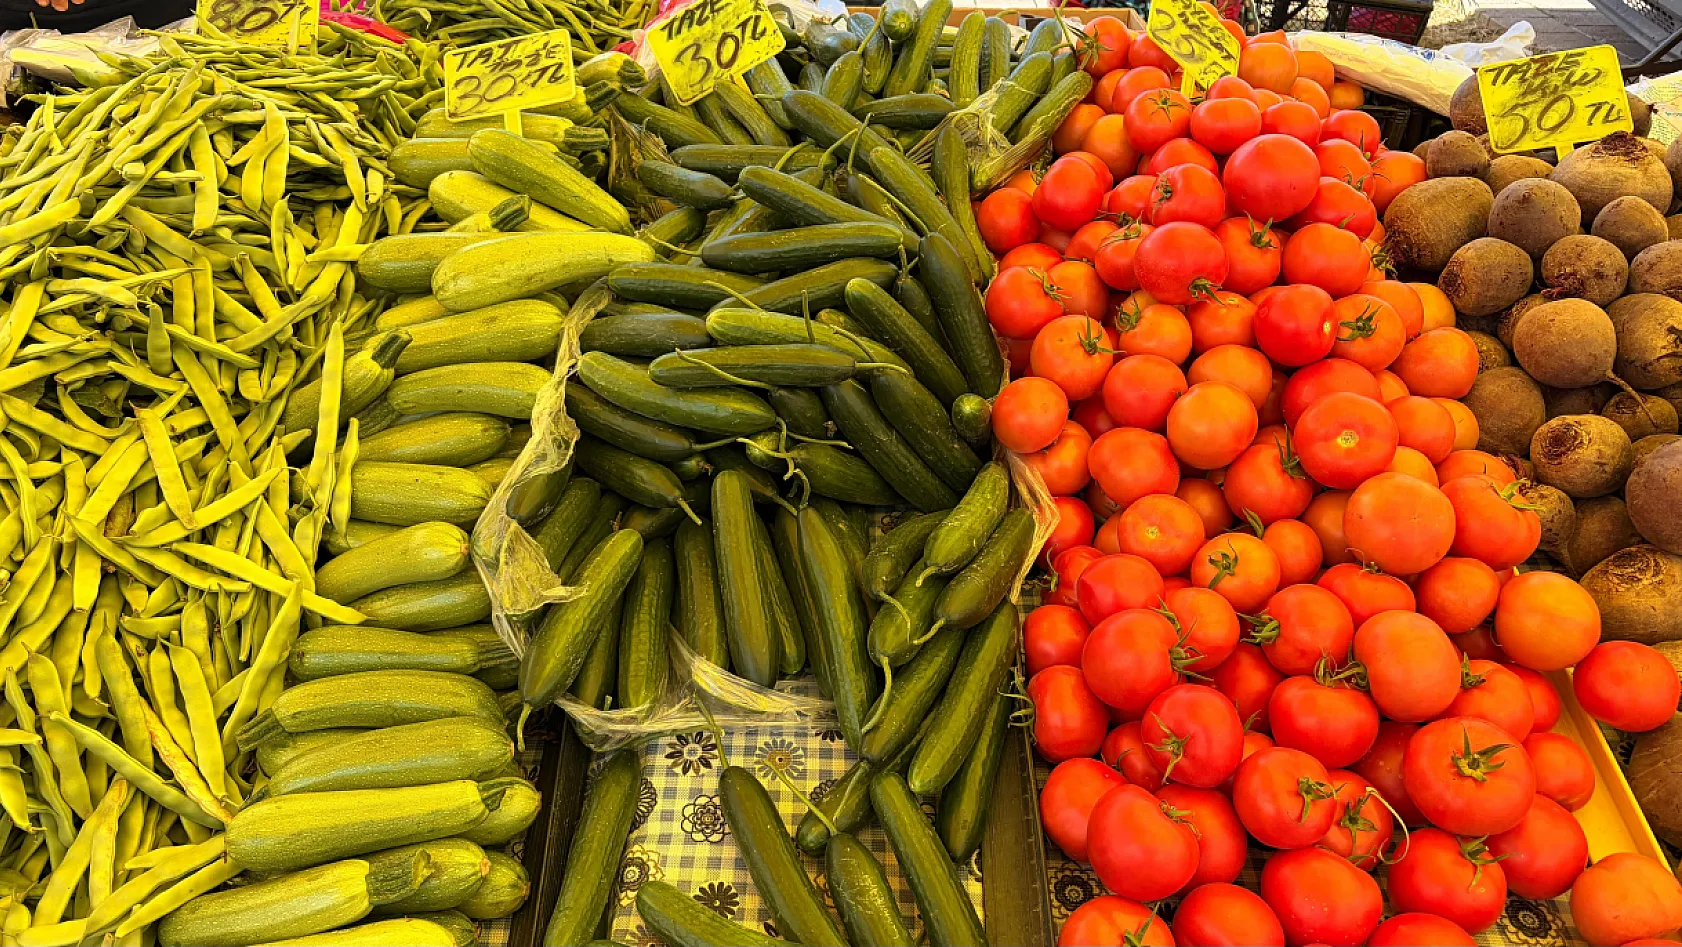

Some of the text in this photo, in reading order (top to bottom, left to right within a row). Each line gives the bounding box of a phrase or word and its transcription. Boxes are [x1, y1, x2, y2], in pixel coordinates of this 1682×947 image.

[660, 0, 732, 40] TAZE
[673, 14, 767, 88] 30 TL
[1483, 51, 1587, 86] TAZE
[451, 74, 517, 118] 30
[1491, 93, 1576, 150] 50
[1585, 100, 1627, 127] TL
